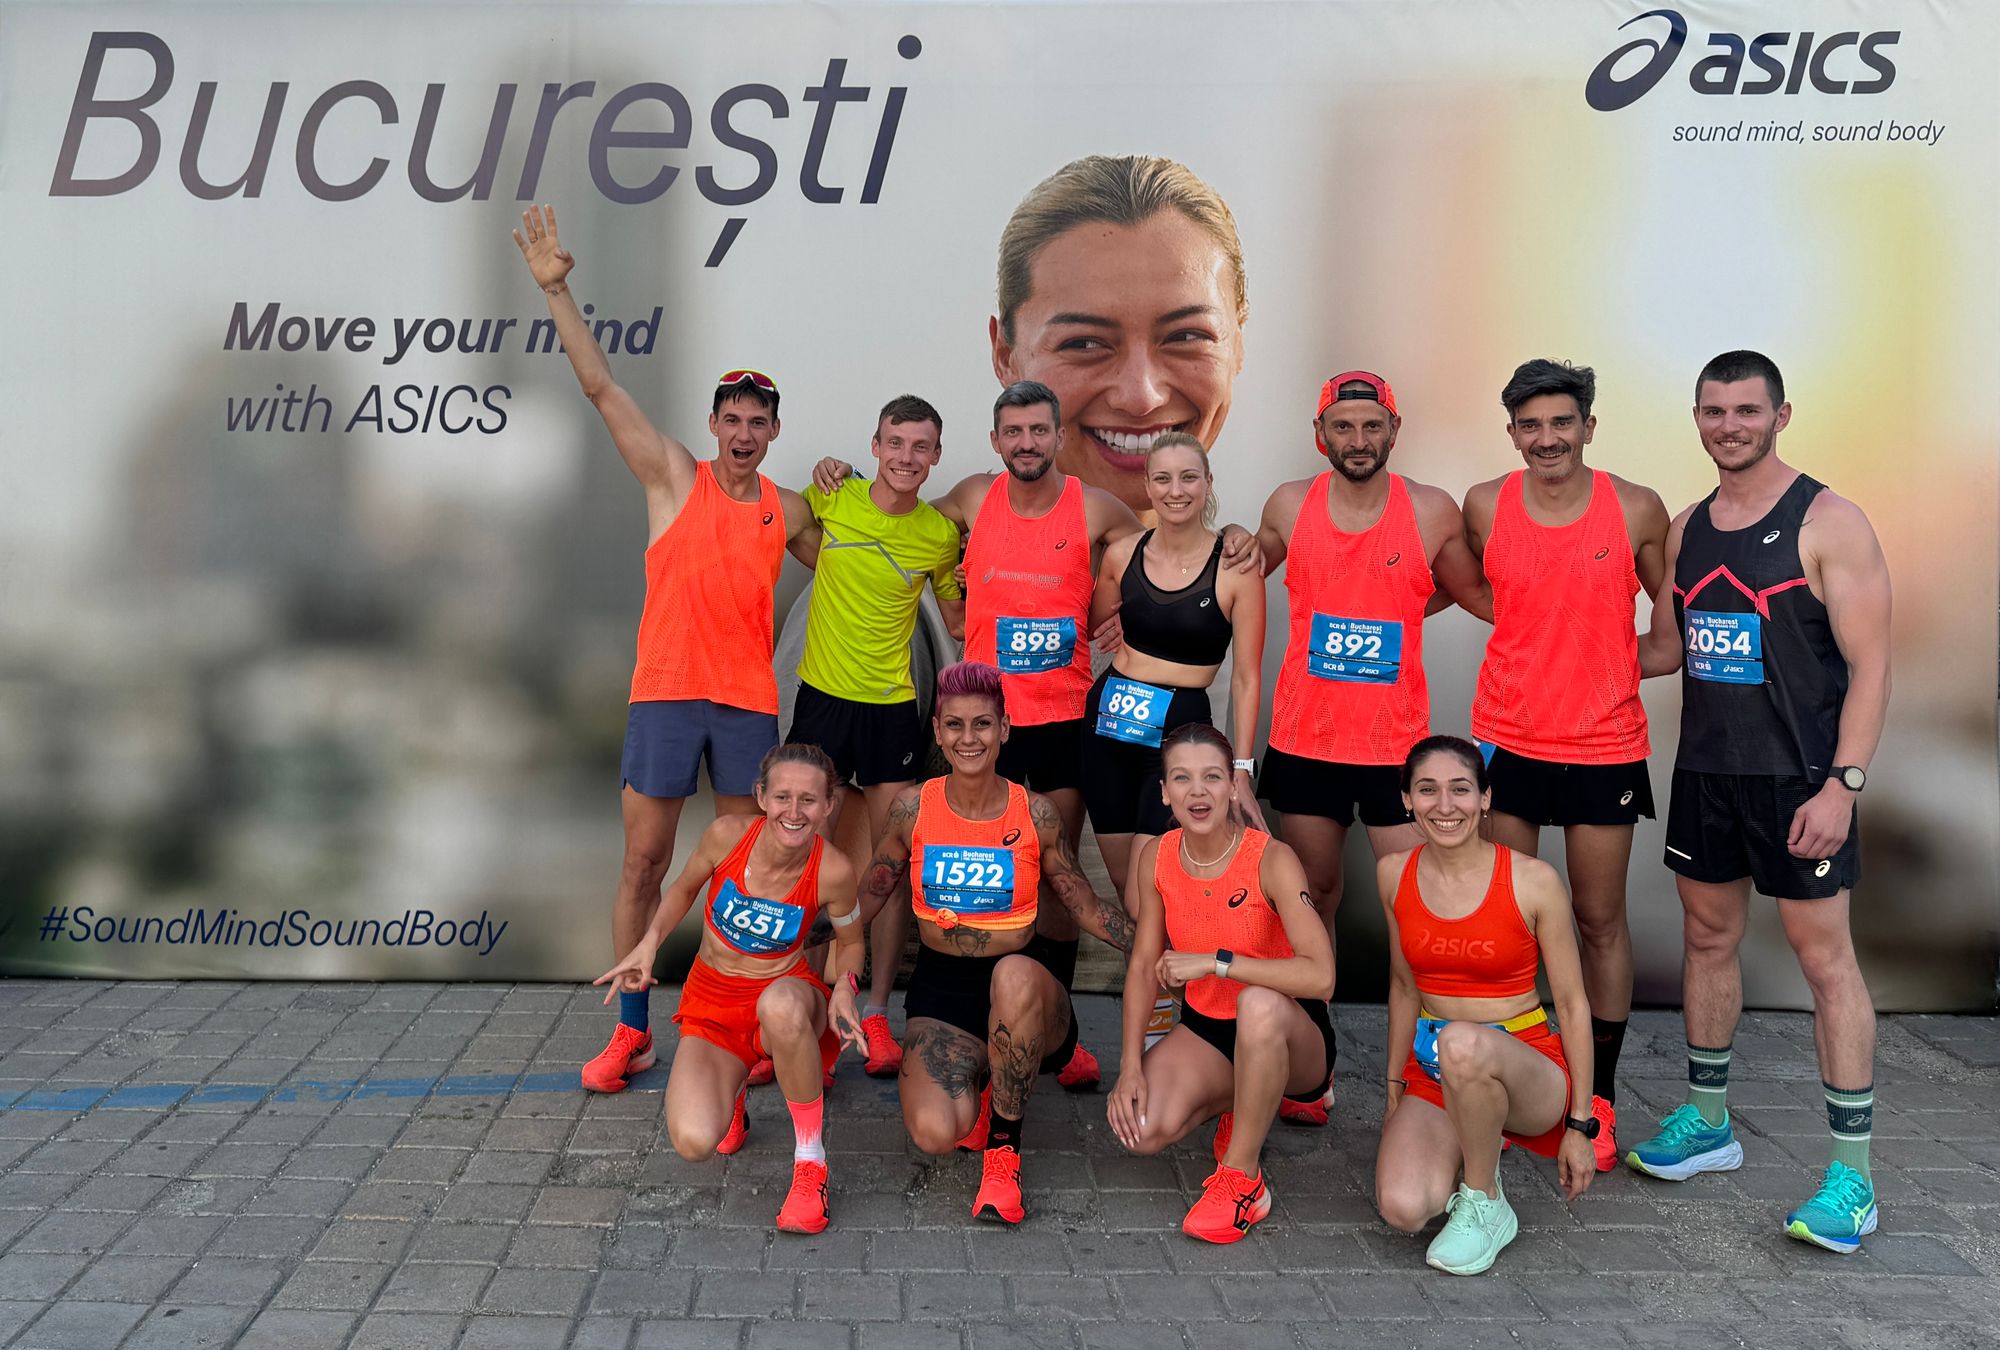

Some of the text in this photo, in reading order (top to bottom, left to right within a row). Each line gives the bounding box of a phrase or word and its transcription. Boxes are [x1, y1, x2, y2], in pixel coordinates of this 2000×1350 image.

[1689, 30, 1901, 95] asics
[1672, 119, 1945, 146] sound mind, sound body
[47, 31, 923, 268] București
[223, 302, 376, 352] Move
[382, 317, 517, 365] your
[227, 383, 512, 434] with ASICS
[1350, 622, 1382, 632] Bucharest
[1707, 616, 1738, 625] Bucharest
[1010, 631, 1061, 652] 898
[1324, 632, 1382, 658] 892
[1688, 626, 1752, 656] 2054
[1323, 662, 1337, 671] BCR
[1108, 692, 1151, 720] 896
[963, 850, 995, 859] Bucharest
[935, 861, 1004, 888] 1522
[939, 894, 953, 903] BCR
[39, 905, 509, 956] #SoundMindSoundBody
[722, 899, 785, 940] 1651
[1430, 935, 1496, 960] asics
